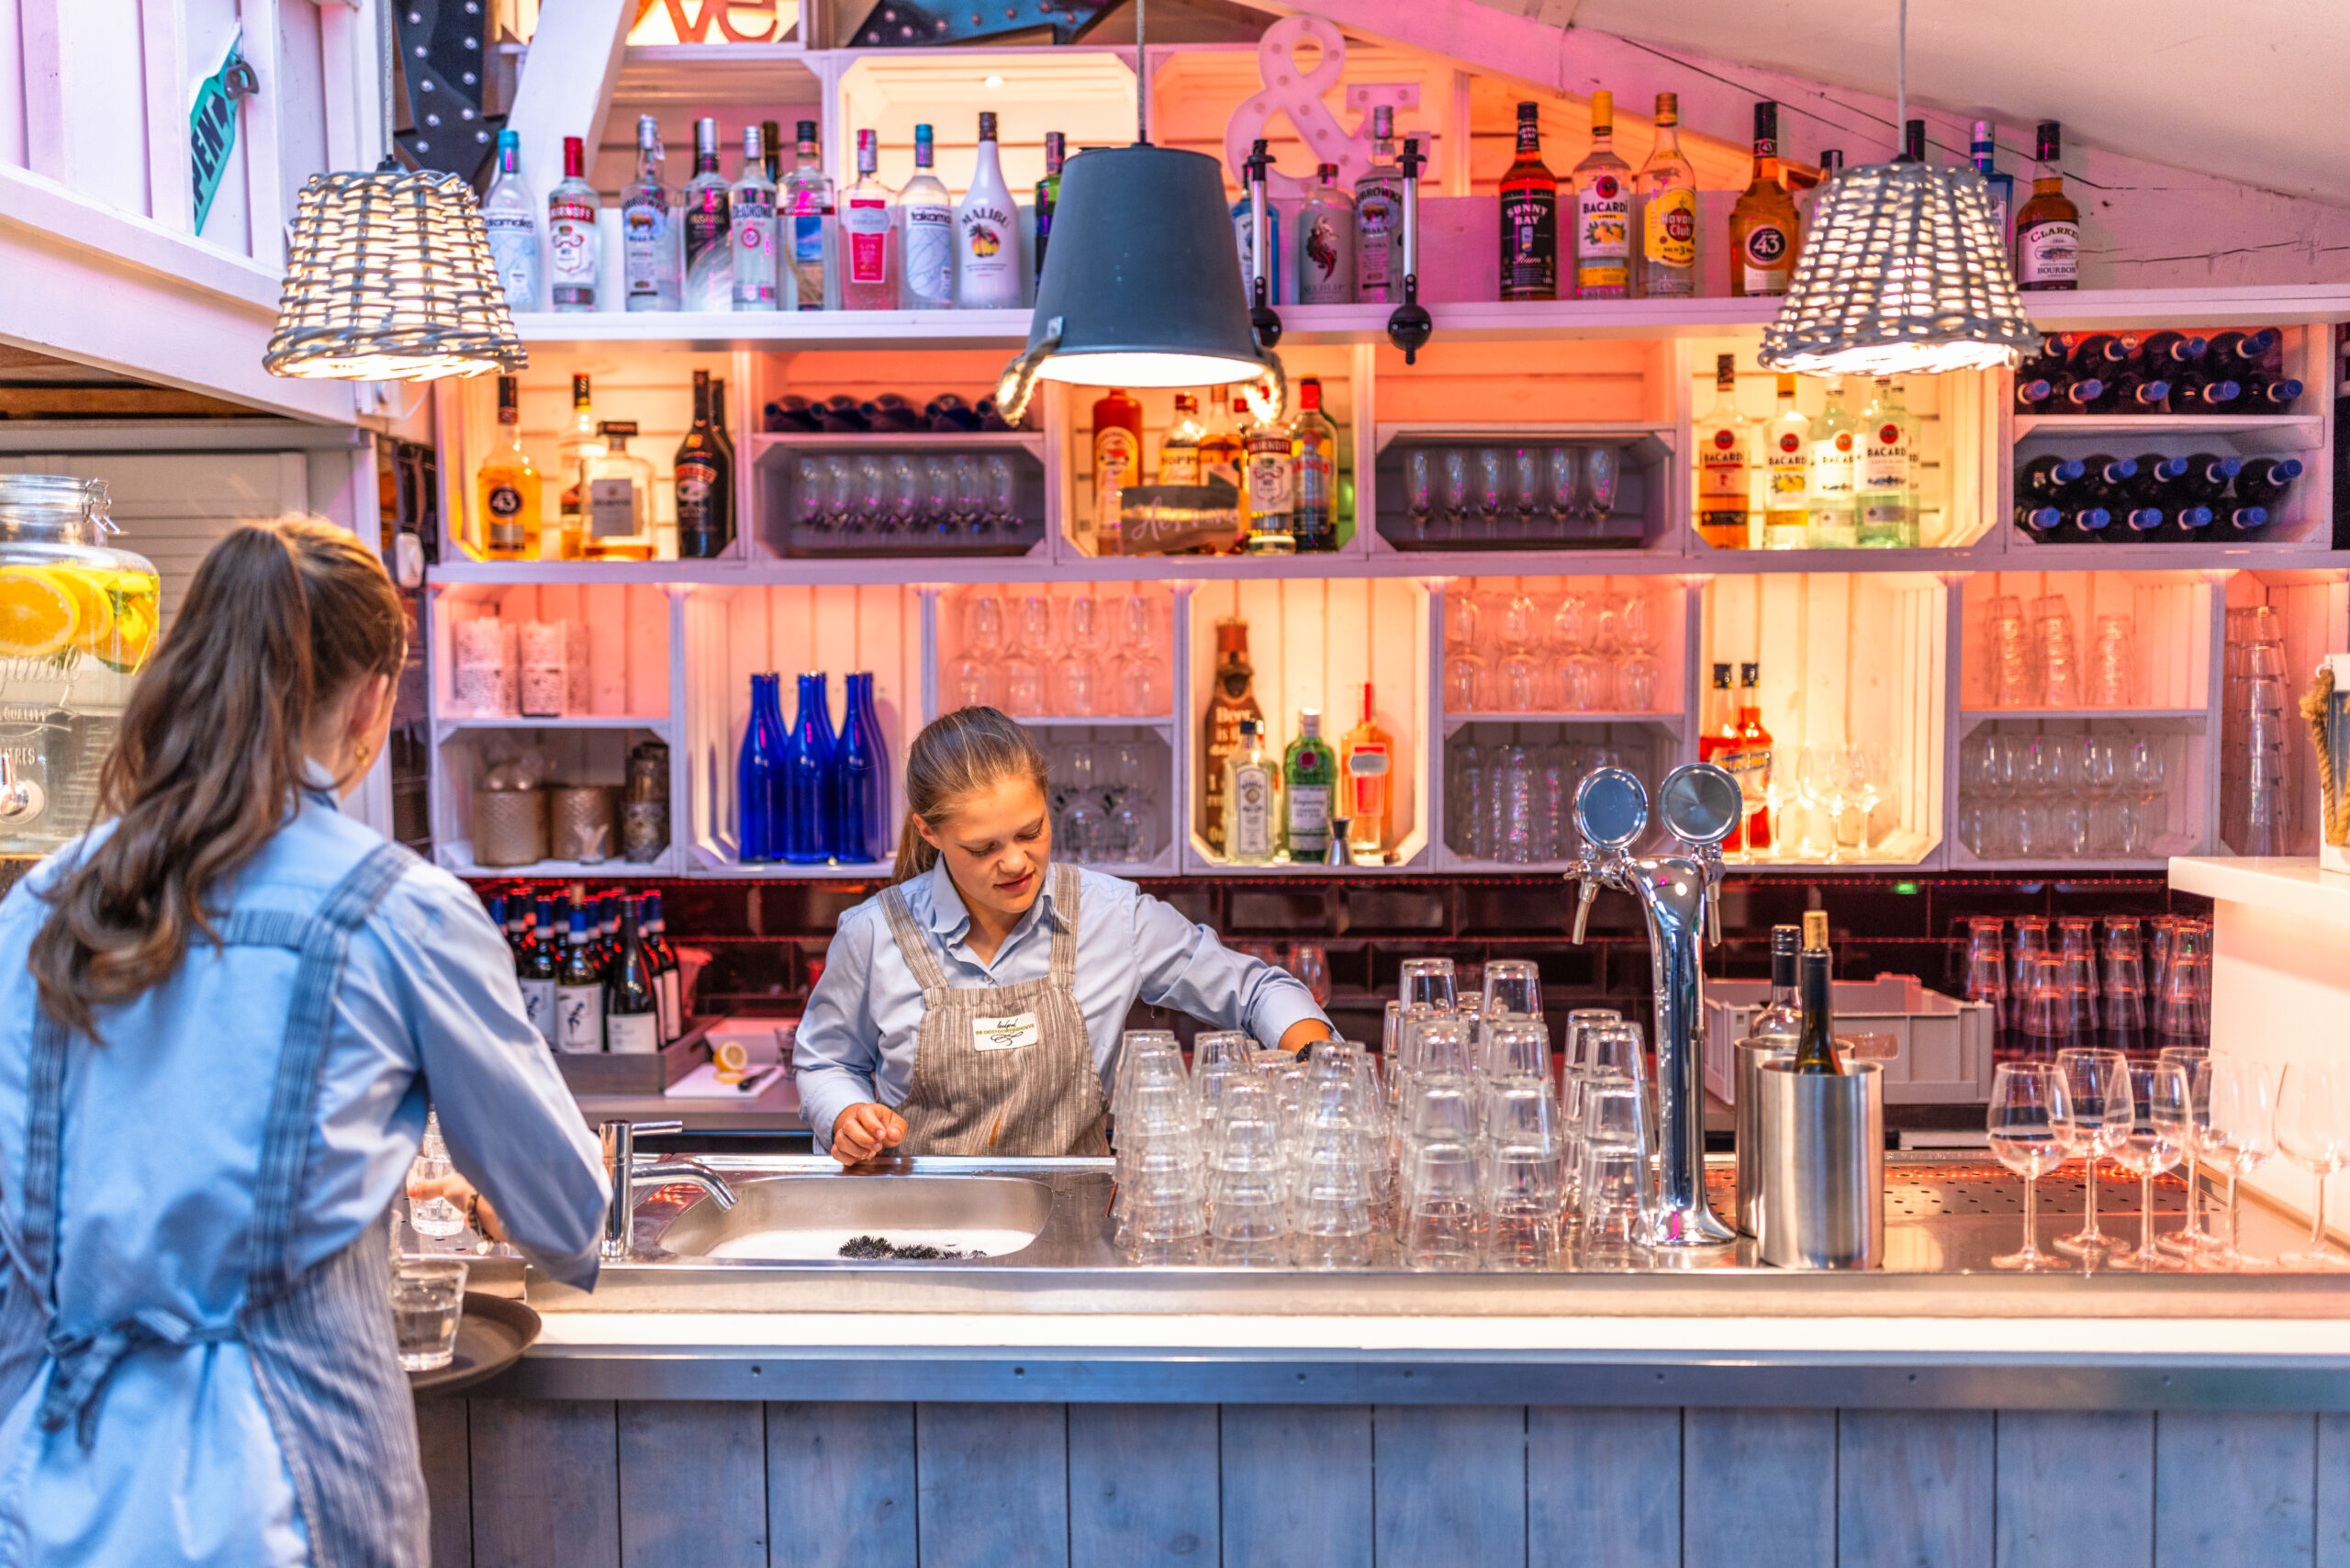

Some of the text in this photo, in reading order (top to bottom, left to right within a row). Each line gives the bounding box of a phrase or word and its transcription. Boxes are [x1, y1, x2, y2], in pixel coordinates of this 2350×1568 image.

[633, 0, 778, 43] ve
[191, 104, 225, 221] PEN
[961, 207, 1010, 229] MALIBU
[1506, 204, 1548, 218] SUNNY
[1515, 216, 1539, 225] BAY
[1670, 224, 1691, 237] Club
[1753, 235, 1780, 253] 43
[2037, 265, 2077, 274] BOURBON
[491, 490, 518, 512] 43
[5, 706, 47, 722] QUALITY
[0, 746, 36, 764] TRES
